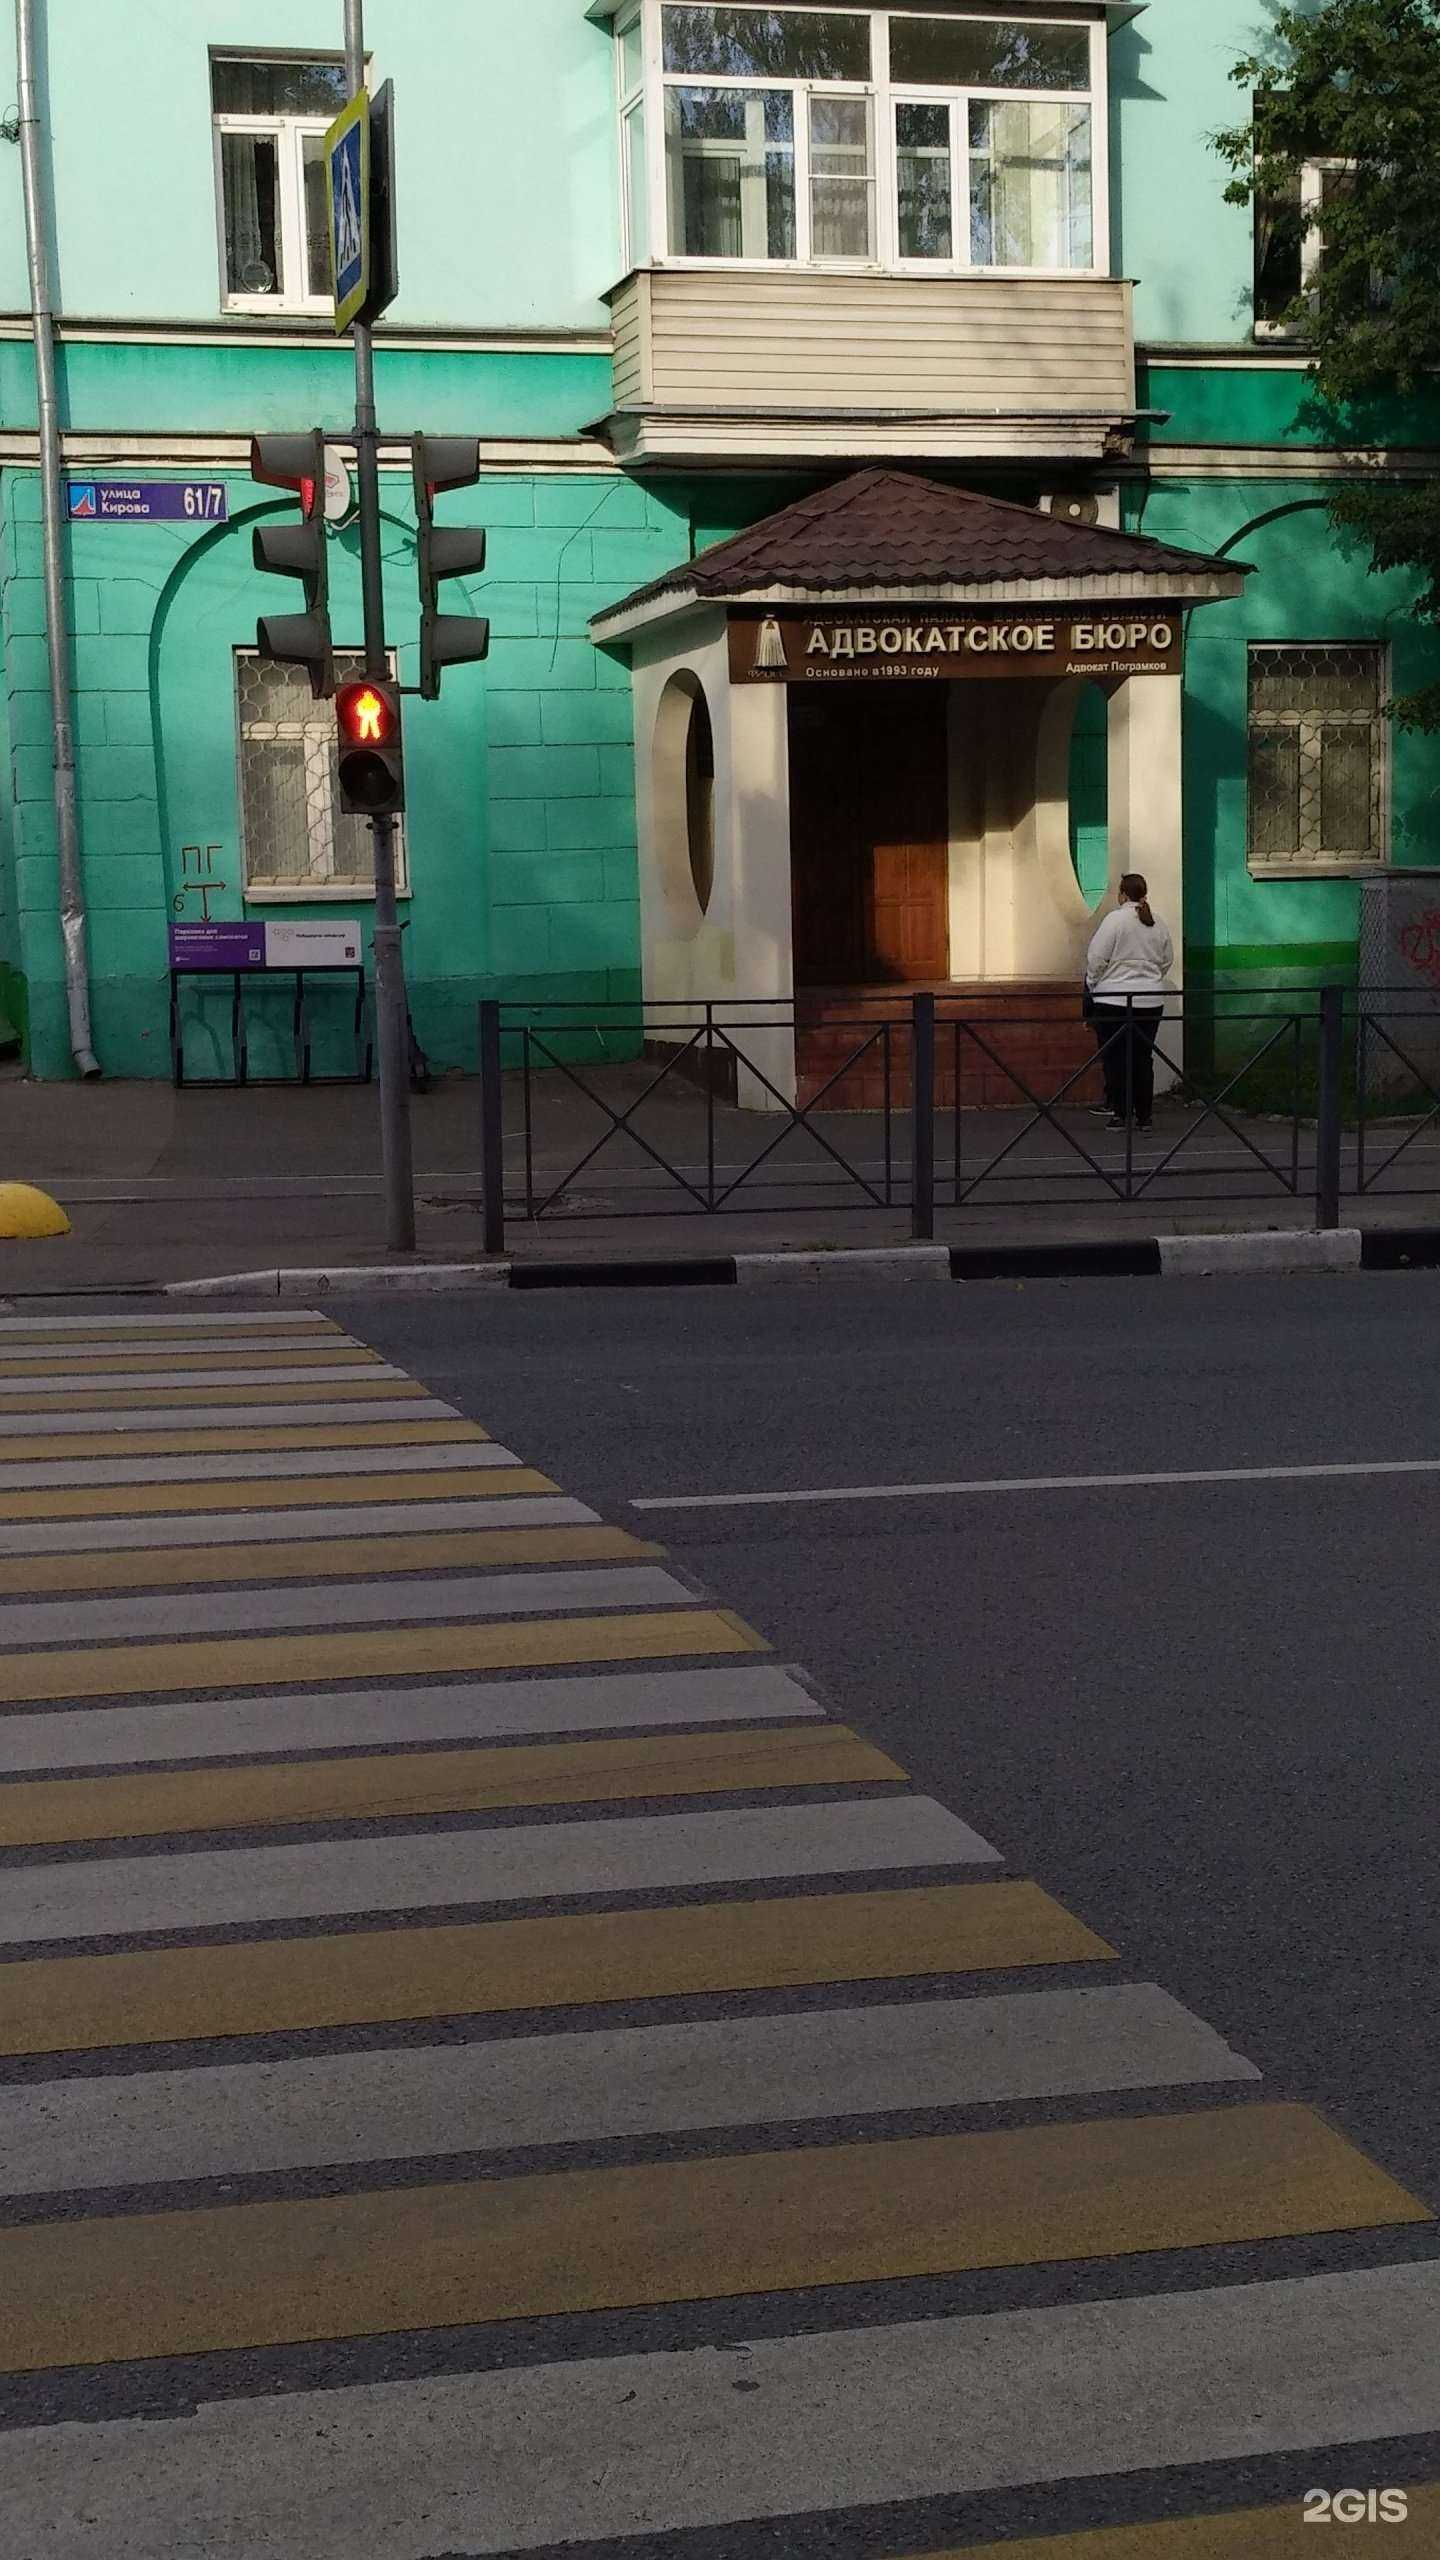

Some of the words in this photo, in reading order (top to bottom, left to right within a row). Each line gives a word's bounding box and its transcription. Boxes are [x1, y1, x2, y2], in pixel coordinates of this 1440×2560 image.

[100, 489, 141, 500] улица
[101, 502, 150, 515] Кирова
[184, 486, 222, 518] 61/7
[805, 624, 1056, 659] АДВОКАТСКОЕ
[1071, 623, 1173, 650] БЮРО
[805, 667, 869, 678] Основано
[910, 665, 940, 678] году
[1066, 662, 1109, 673] Адвокат
[1111, 660, 1167, 673] Пограмков
[182, 846, 223, 874] ПГ
